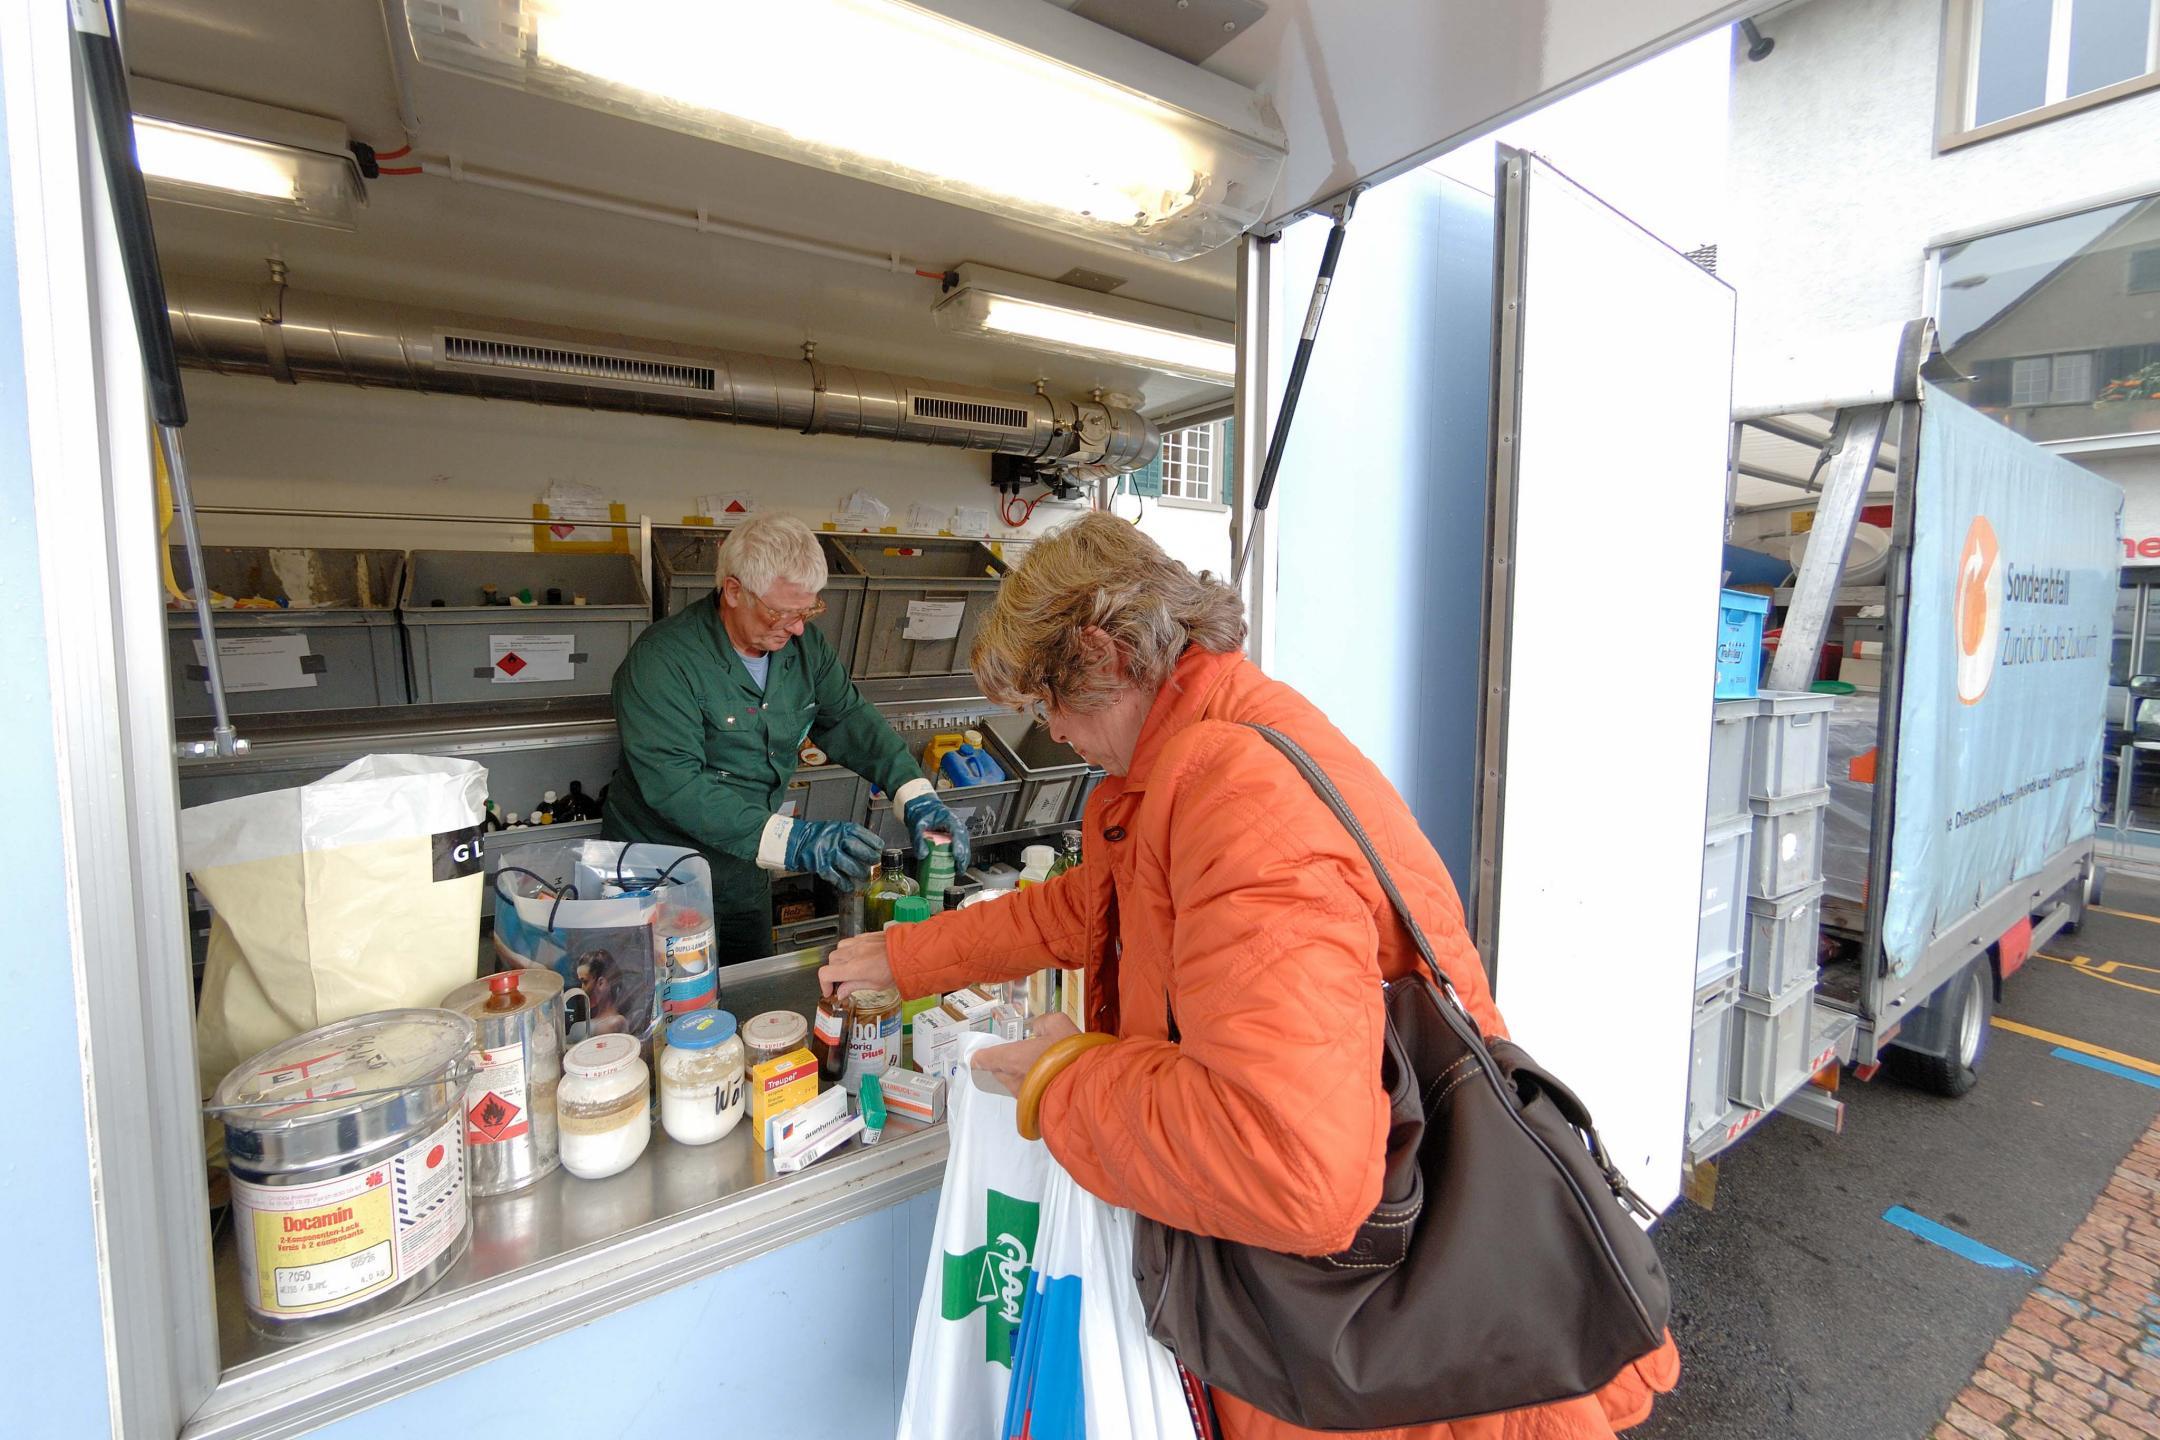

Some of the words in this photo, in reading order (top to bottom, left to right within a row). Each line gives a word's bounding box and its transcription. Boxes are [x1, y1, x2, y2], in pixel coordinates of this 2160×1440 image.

[2007, 562, 2070, 605] Sonderabfall
[2002, 625, 2034, 666] Zurück
[768, 1072, 796, 1089] Treupel
[283, 1207, 353, 1233] Docamin
[280, 1222, 360, 1244] 2-Komponenten-Lack
[316, 1229, 364, 1248] composants
[288, 1270, 311, 1283] 7050
